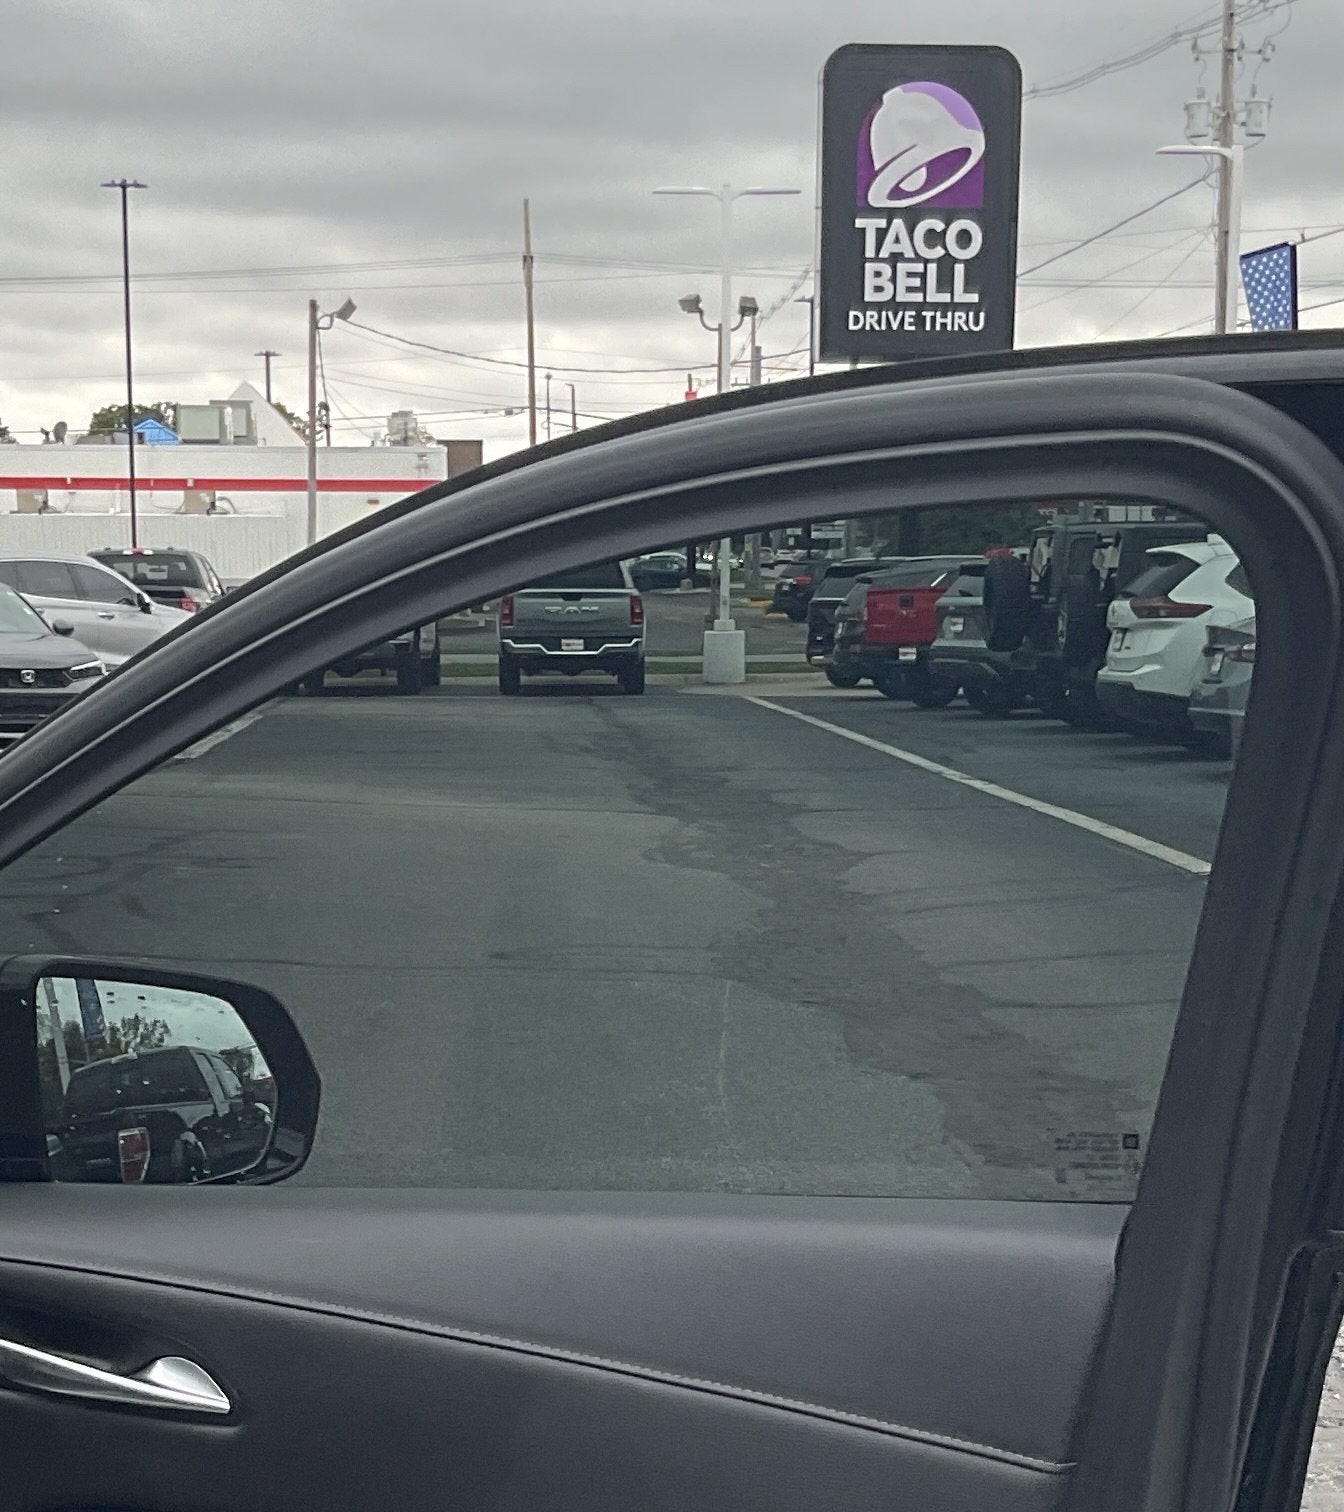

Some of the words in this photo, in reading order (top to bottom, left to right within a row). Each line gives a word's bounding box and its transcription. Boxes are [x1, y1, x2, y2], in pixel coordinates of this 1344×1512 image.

[855, 218, 983, 260] TACO
[864, 262, 979, 303] BELL
[848, 310, 916, 331] DRIVE
[922, 311, 985, 332] THRU
